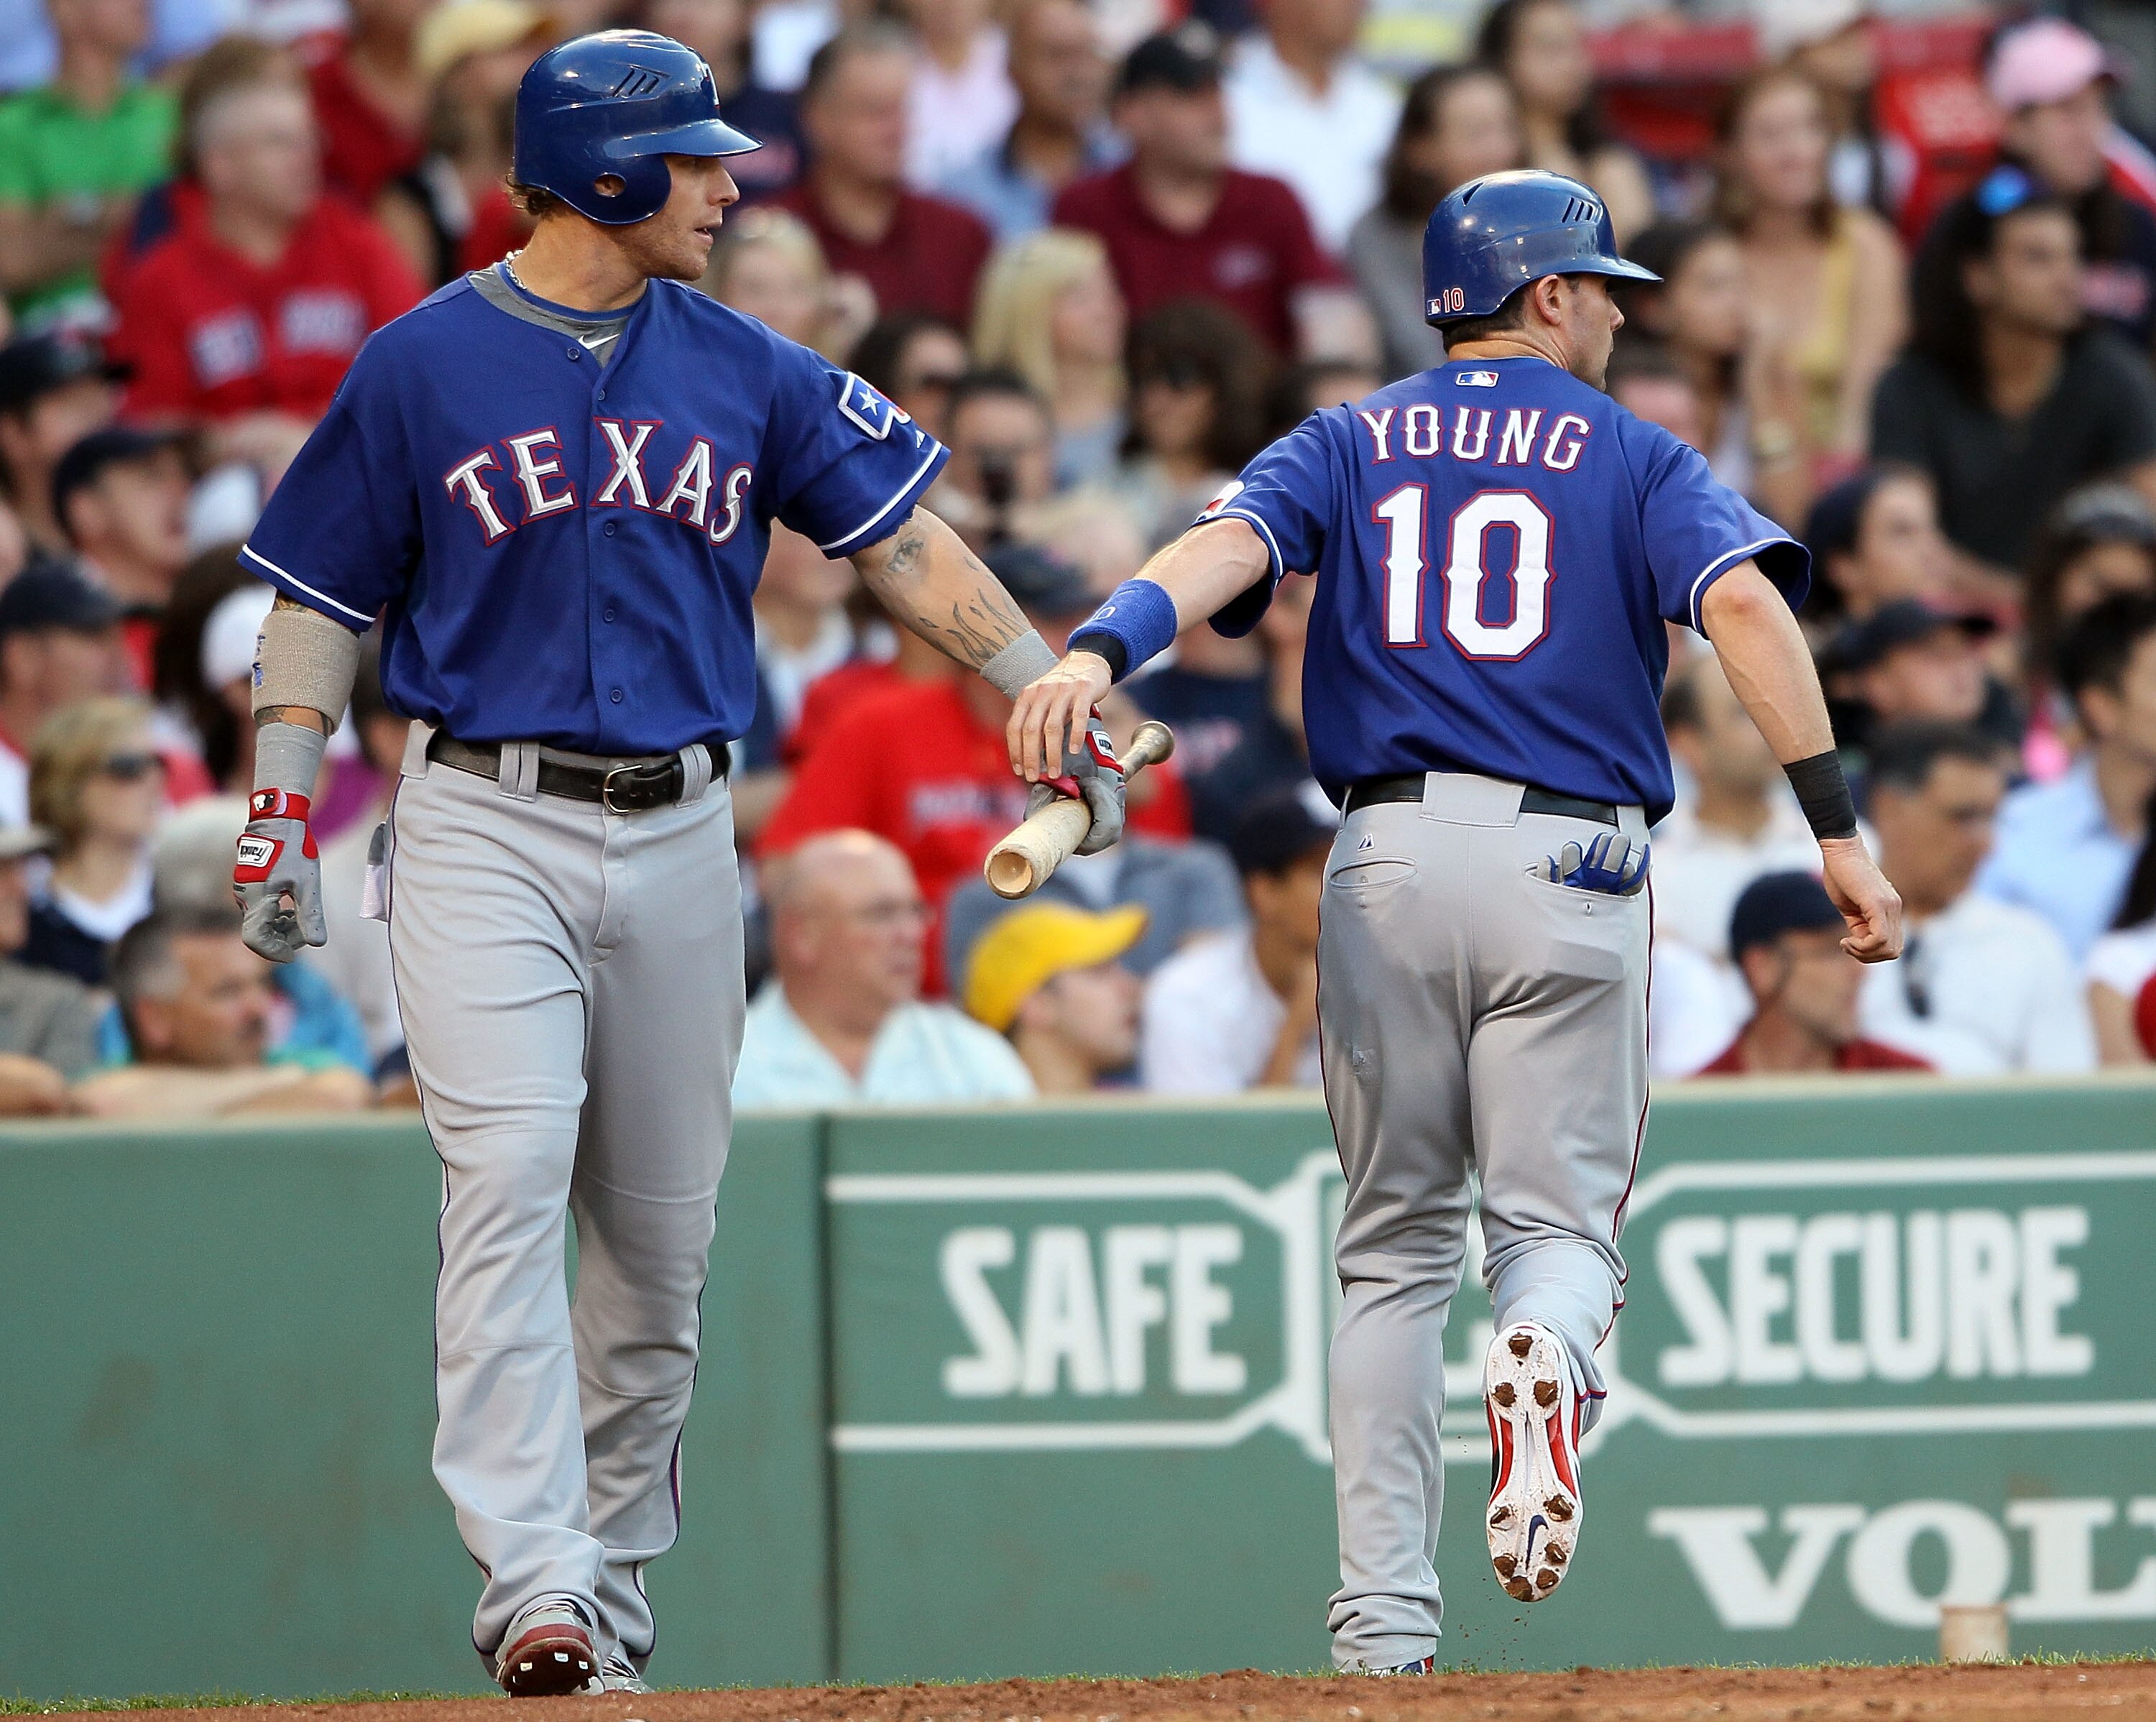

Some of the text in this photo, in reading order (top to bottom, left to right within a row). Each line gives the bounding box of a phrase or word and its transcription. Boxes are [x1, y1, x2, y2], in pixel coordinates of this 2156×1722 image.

[1442, 287, 1465, 313] 10
[443, 417, 754, 547] TEXAS
[1357, 402, 1593, 474] YOUNG
[1372, 481, 1557, 662] 10
[940, 1225, 1248, 1398] SAFE
[1656, 1205, 2095, 1386] SECURE
[1646, 1497, 2156, 1629] VOL
